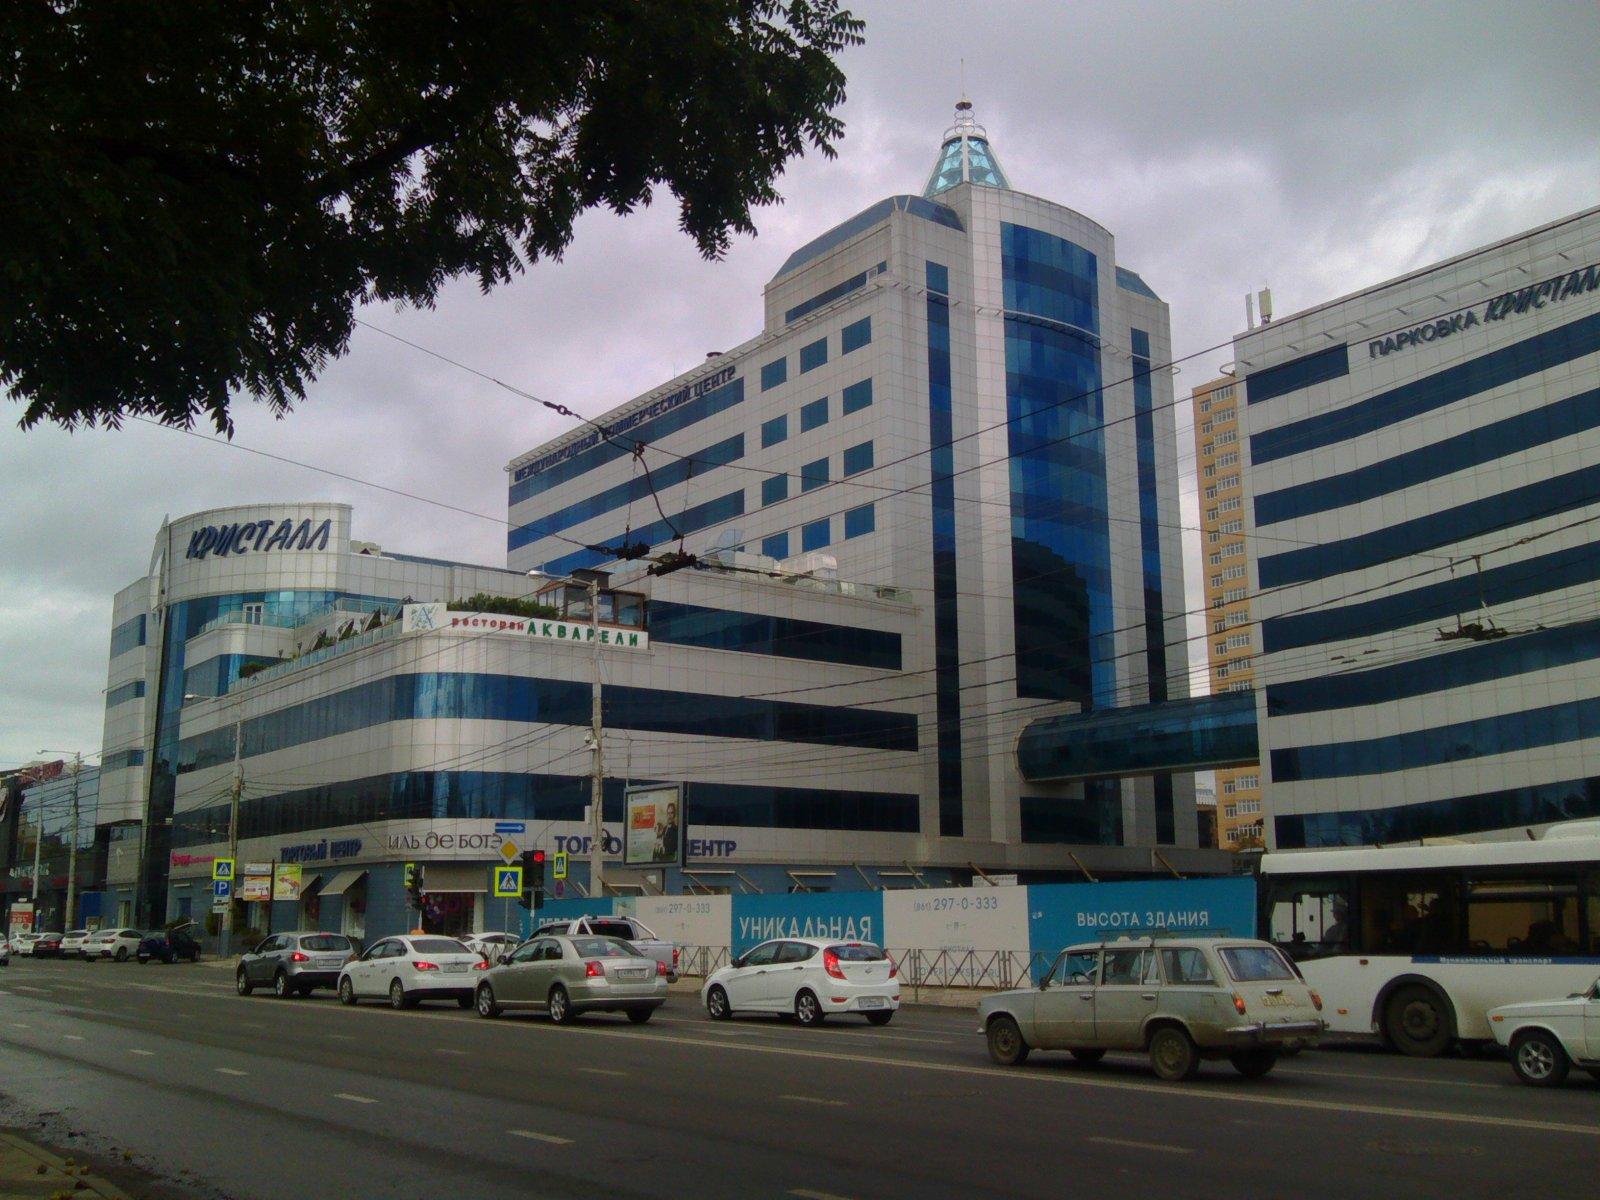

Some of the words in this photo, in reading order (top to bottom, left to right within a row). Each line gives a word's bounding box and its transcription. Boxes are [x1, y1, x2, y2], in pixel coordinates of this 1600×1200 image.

[1368, 310, 1480, 359] ПАРКОВКА
[185, 518, 332, 560] КРИСТАЛЛ
[527, 620, 639, 648] АКВАРЕЛИ
[388, 835, 420, 849] ИЛЬ
[669, 903, 711, 914] 297-0-333
[934, 897, 998, 911] 297-0-333
[739, 916, 871, 941] УНИКАЛЬНАЯ
[1077, 911, 1140, 927] ВЫСОТА
[1145, 911, 1209, 928] ЗДАНИЯ
